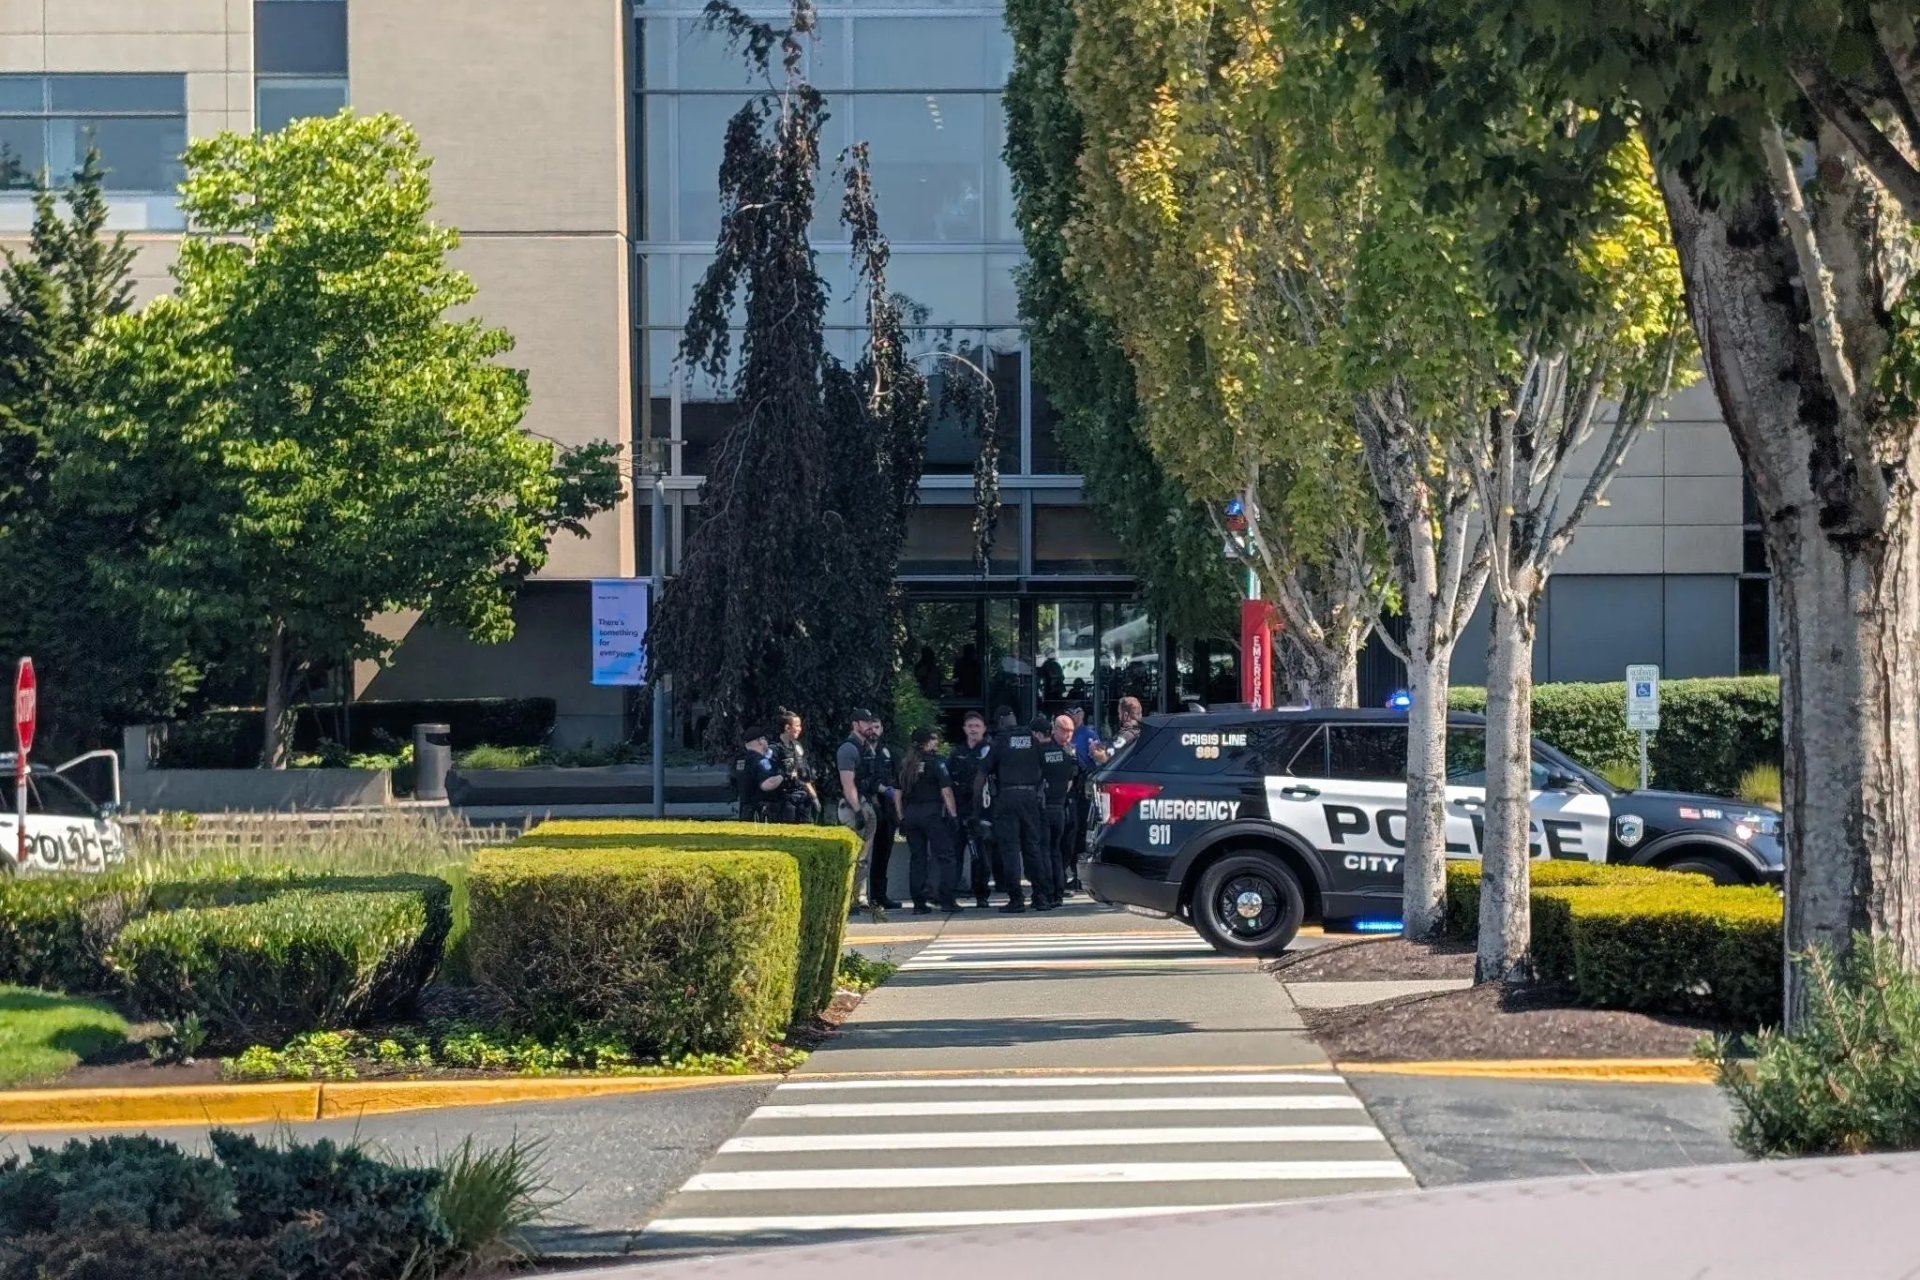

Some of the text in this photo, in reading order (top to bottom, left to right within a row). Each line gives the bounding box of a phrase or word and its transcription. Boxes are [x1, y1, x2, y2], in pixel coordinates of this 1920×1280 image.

[598, 618, 625, 626] There's
[599, 628, 639, 638] something
[599, 638, 610, 647] for
[1181, 733, 1247, 747] CRISIS LINE
[1140, 800, 1240, 821] EMERGENCY
[1148, 824, 1171, 845] 911
[1322, 803, 1590, 861] POIE
[1344, 854, 1399, 873] CITY
